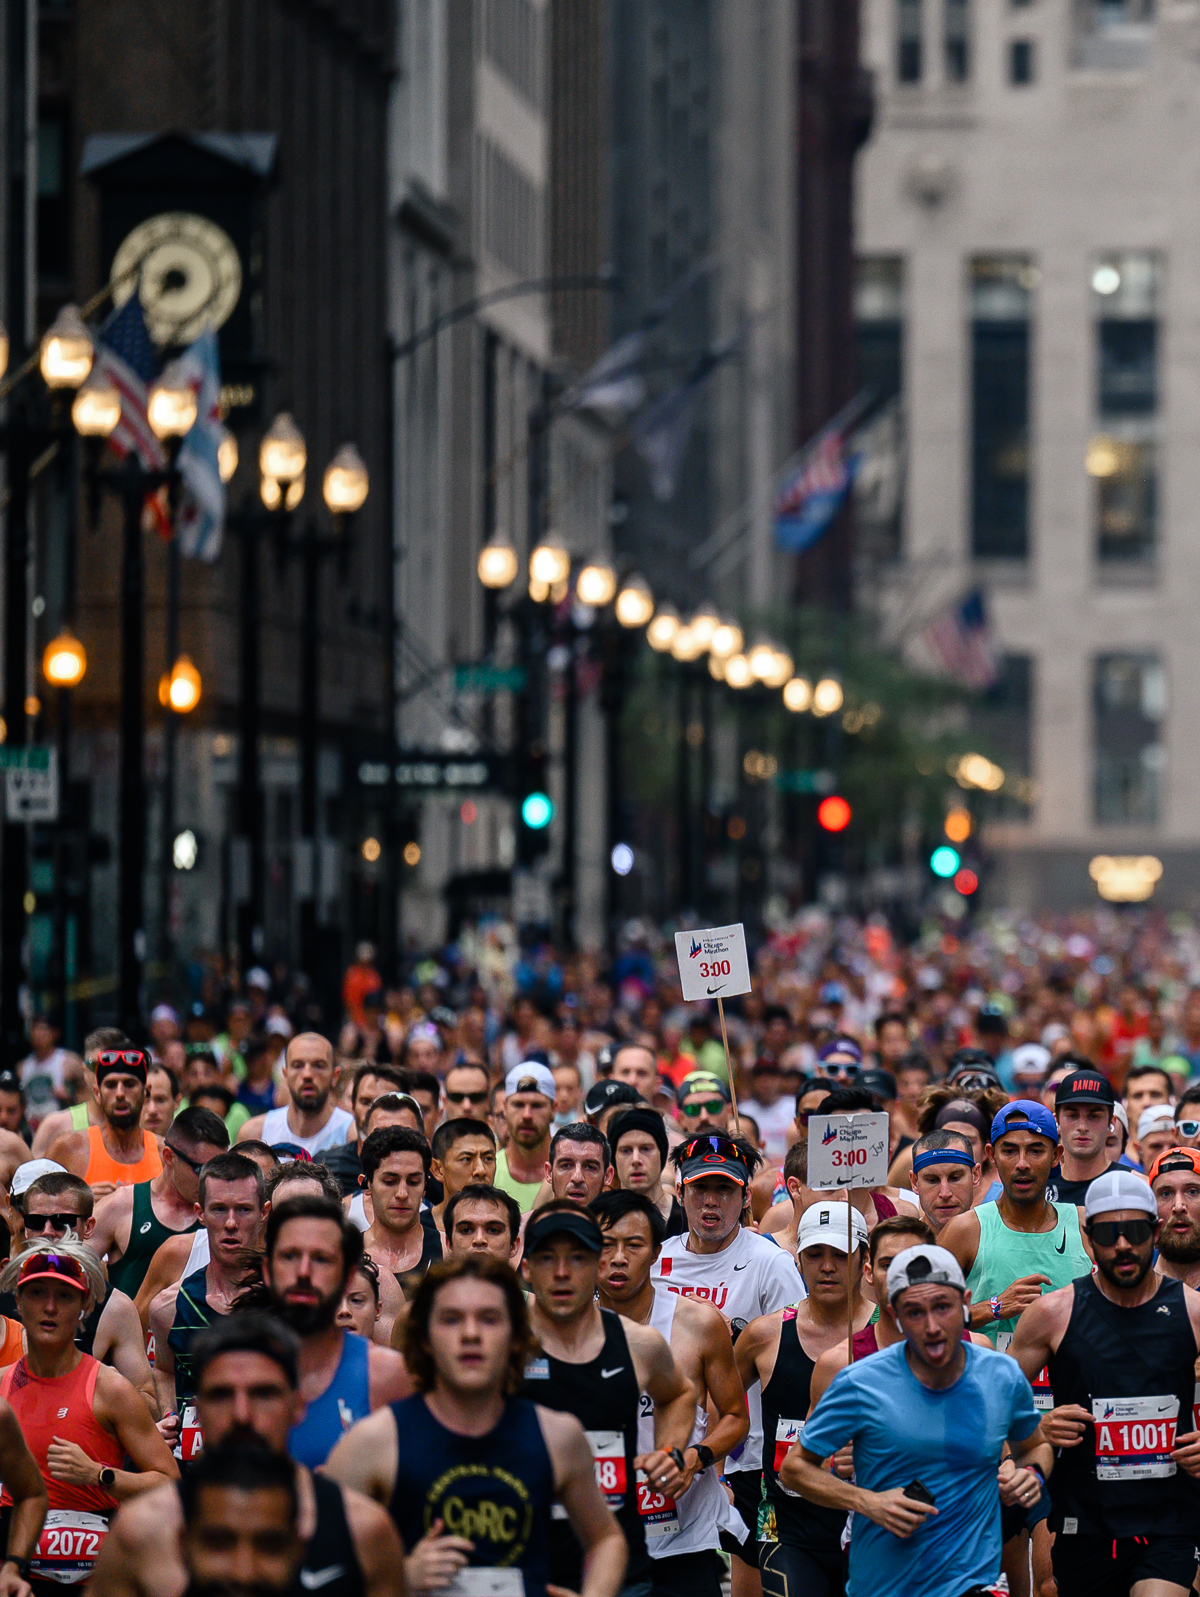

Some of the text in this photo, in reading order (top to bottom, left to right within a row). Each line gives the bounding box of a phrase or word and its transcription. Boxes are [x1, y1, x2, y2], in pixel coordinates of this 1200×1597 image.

[704, 947, 729, 955] Marathon
[700, 960, 731, 978] 3:00
[1072, 1079, 1101, 1093] BANDIT
[839, 1129, 862, 1137] Chicago
[831, 1148, 867, 1167] 3:00
[147, 1335, 156, 1356] A
[190, 1431, 204, 1456] A
[1099, 1421, 1178, 1451] A 10017
[47, 1530, 99, 1556] 2072
